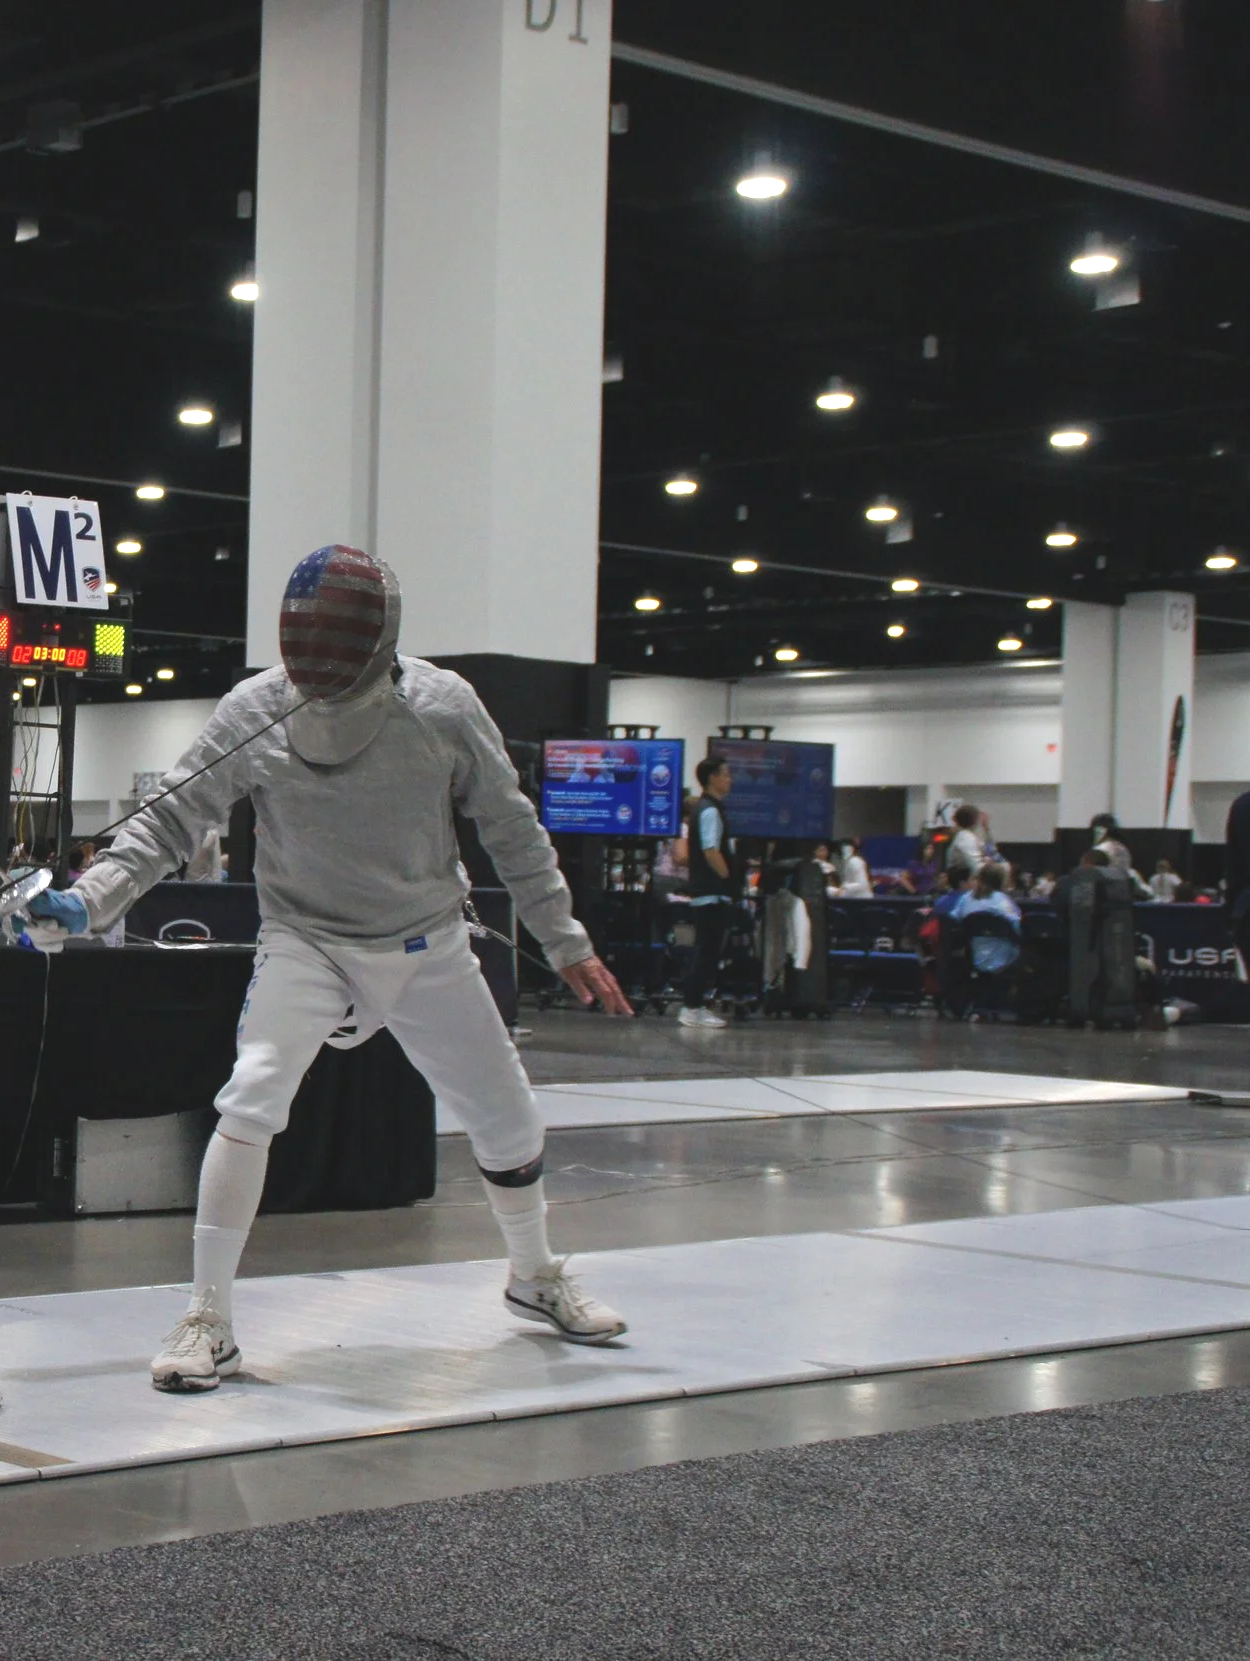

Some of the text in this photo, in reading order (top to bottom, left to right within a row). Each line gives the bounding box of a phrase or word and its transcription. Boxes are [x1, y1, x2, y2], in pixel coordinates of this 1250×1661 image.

[12, 646, 87, 666] 02 03:00 08
[1168, 947, 1238, 965] USA
